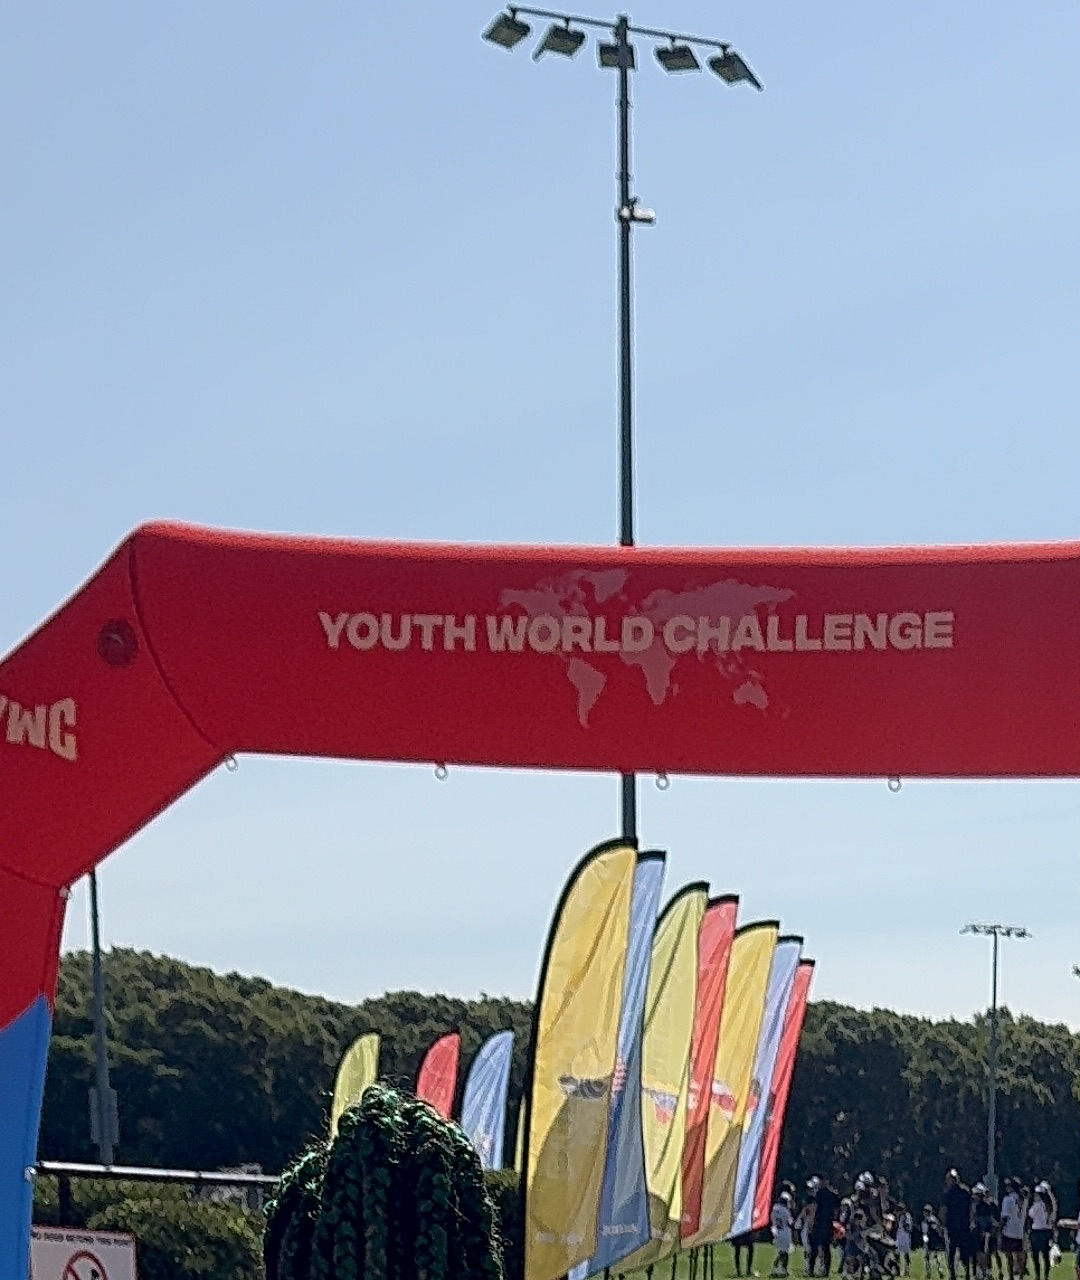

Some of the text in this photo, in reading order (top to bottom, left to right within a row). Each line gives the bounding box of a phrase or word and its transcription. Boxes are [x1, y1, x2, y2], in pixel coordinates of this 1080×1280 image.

[318, 611, 955, 654] YOUTH WORLD CHALLENGE
